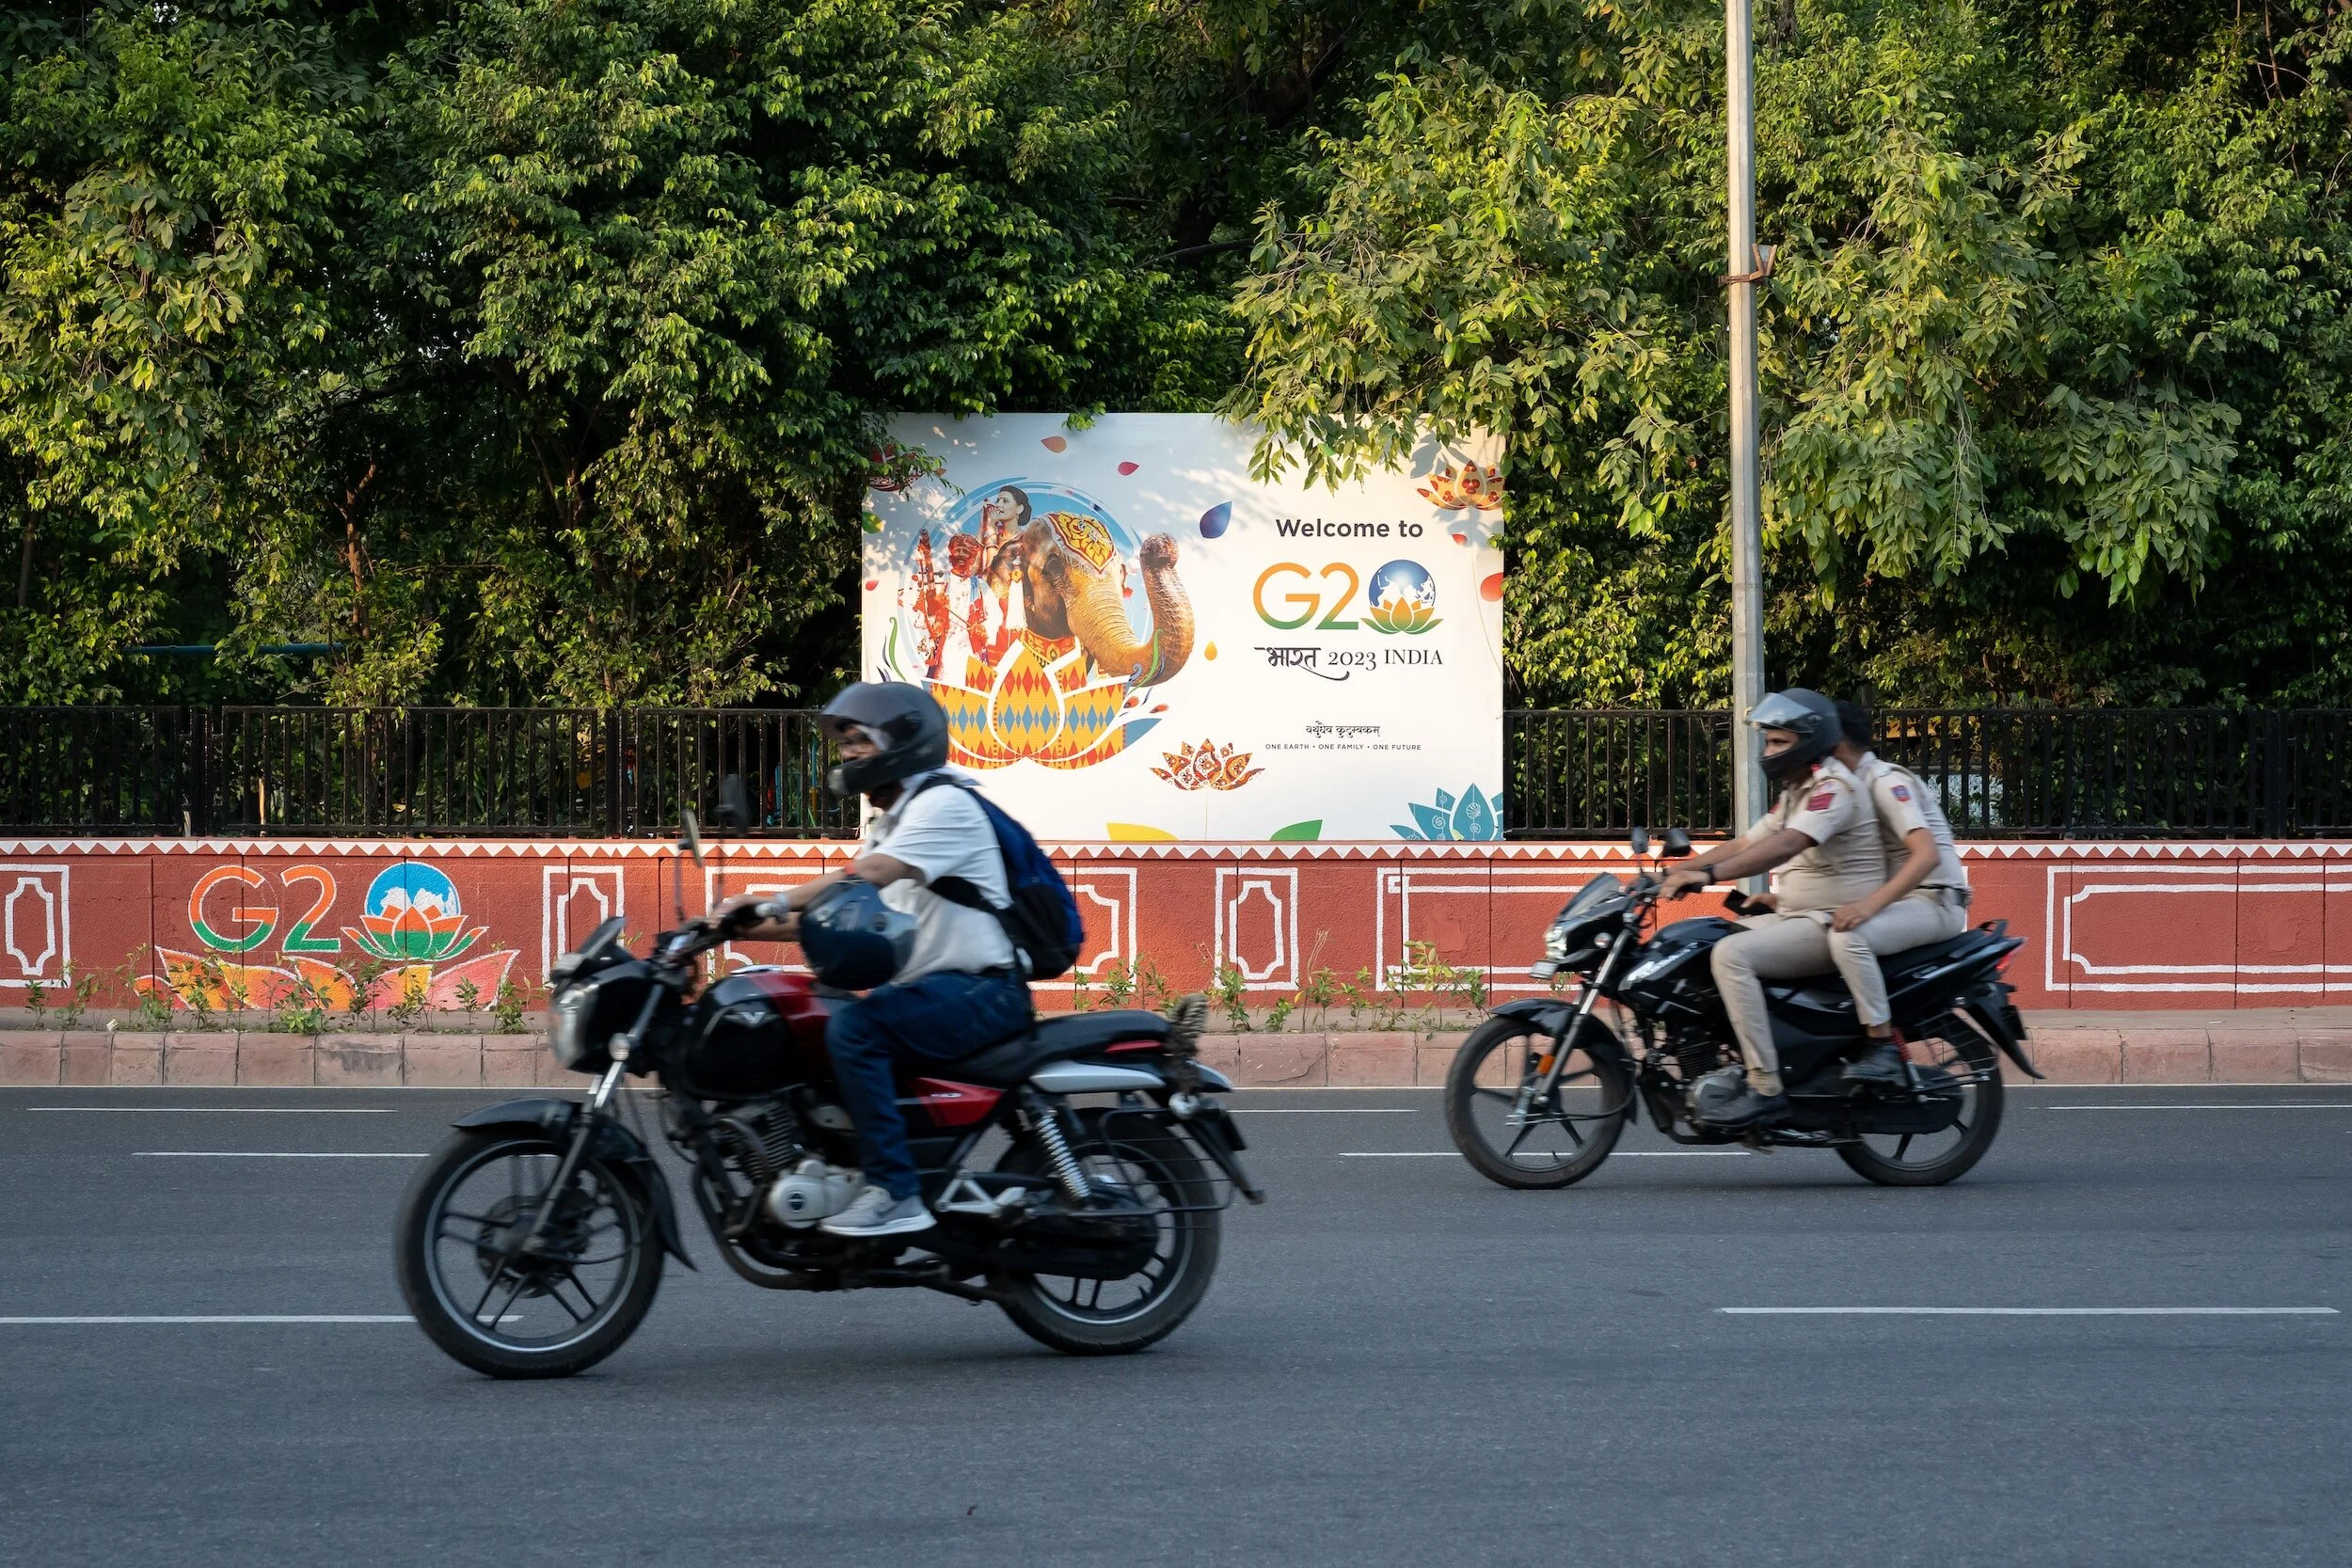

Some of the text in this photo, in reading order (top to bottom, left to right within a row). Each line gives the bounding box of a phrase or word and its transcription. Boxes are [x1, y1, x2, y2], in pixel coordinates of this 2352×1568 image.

[1275, 518, 1423, 538] Welcome to
[1253, 646, 1444, 682] भारत 2023 INDIA
